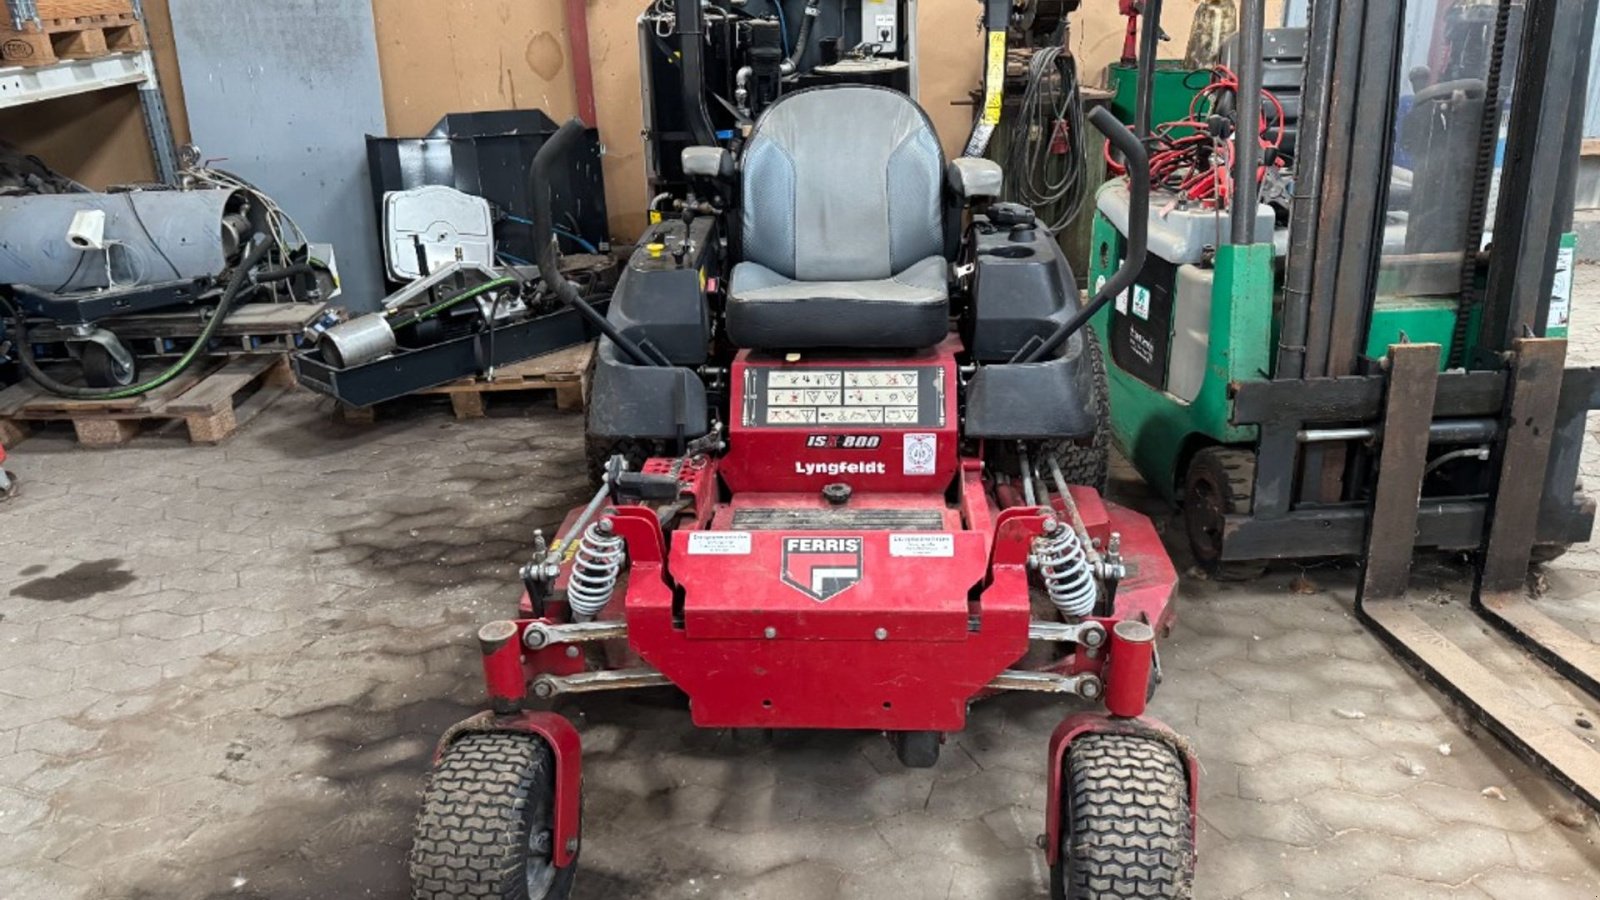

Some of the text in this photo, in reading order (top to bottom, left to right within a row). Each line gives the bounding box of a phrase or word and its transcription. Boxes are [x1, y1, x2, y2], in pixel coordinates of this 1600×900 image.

[842, 435, 880, 448] 800
[795, 461, 885, 475] Lyngfeldt
[787, 538, 858, 552] FERRIS
